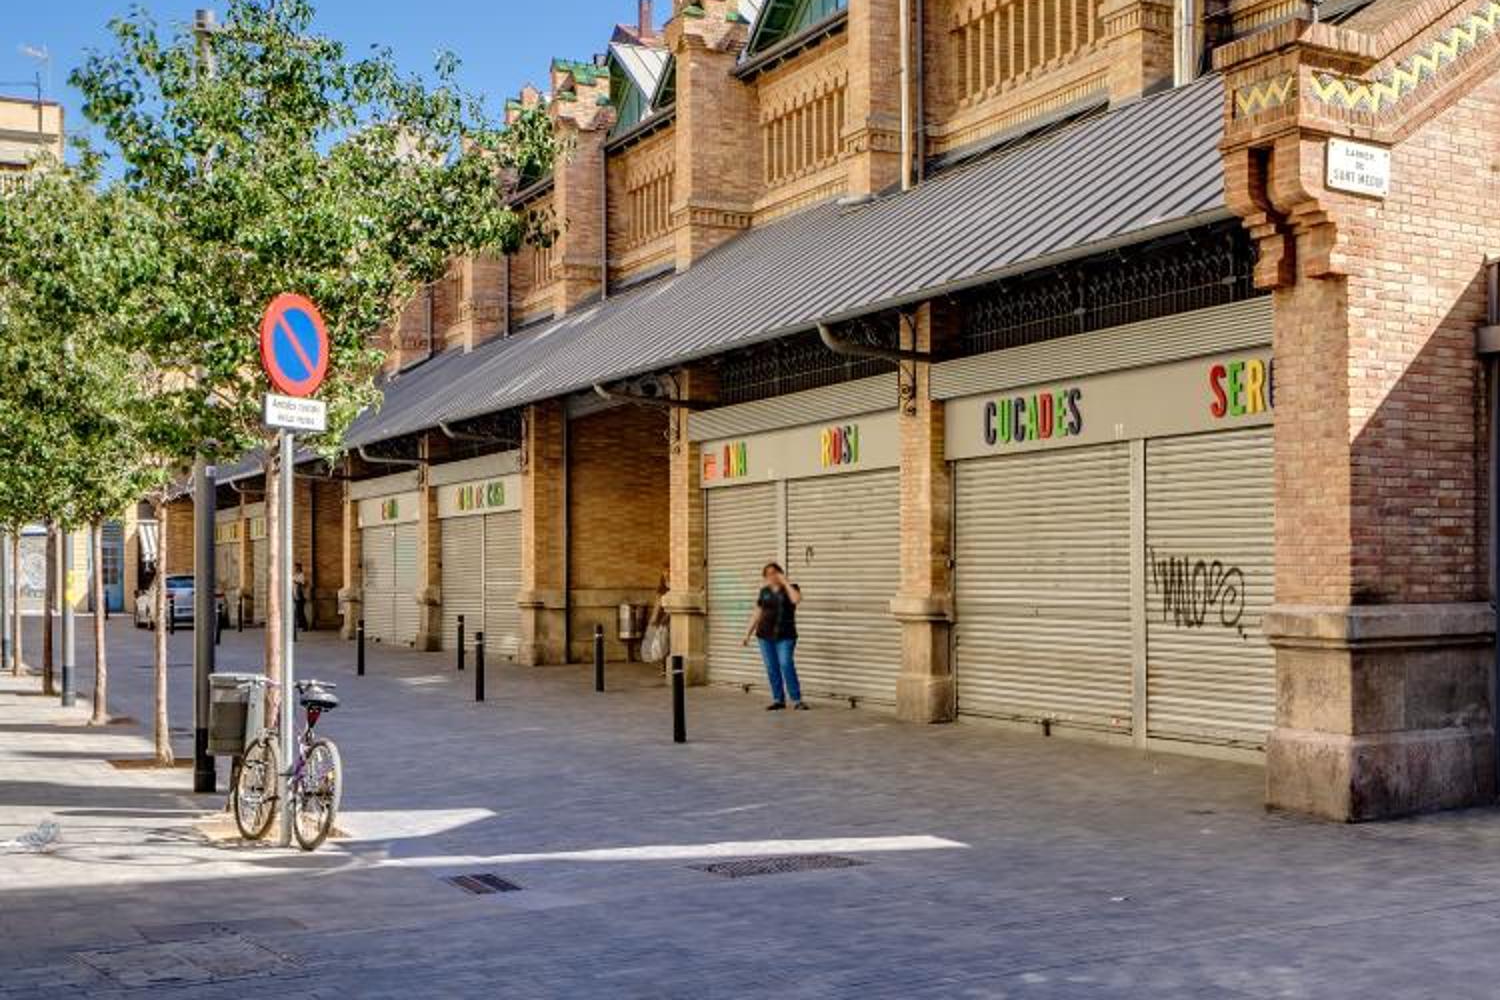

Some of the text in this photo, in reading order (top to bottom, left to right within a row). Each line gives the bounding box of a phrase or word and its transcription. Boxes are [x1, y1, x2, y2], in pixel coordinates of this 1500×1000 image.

[984, 387, 1083, 445] CUCADES
[723, 441, 748, 479] ANA
[820, 423, 860, 469] ROSI
